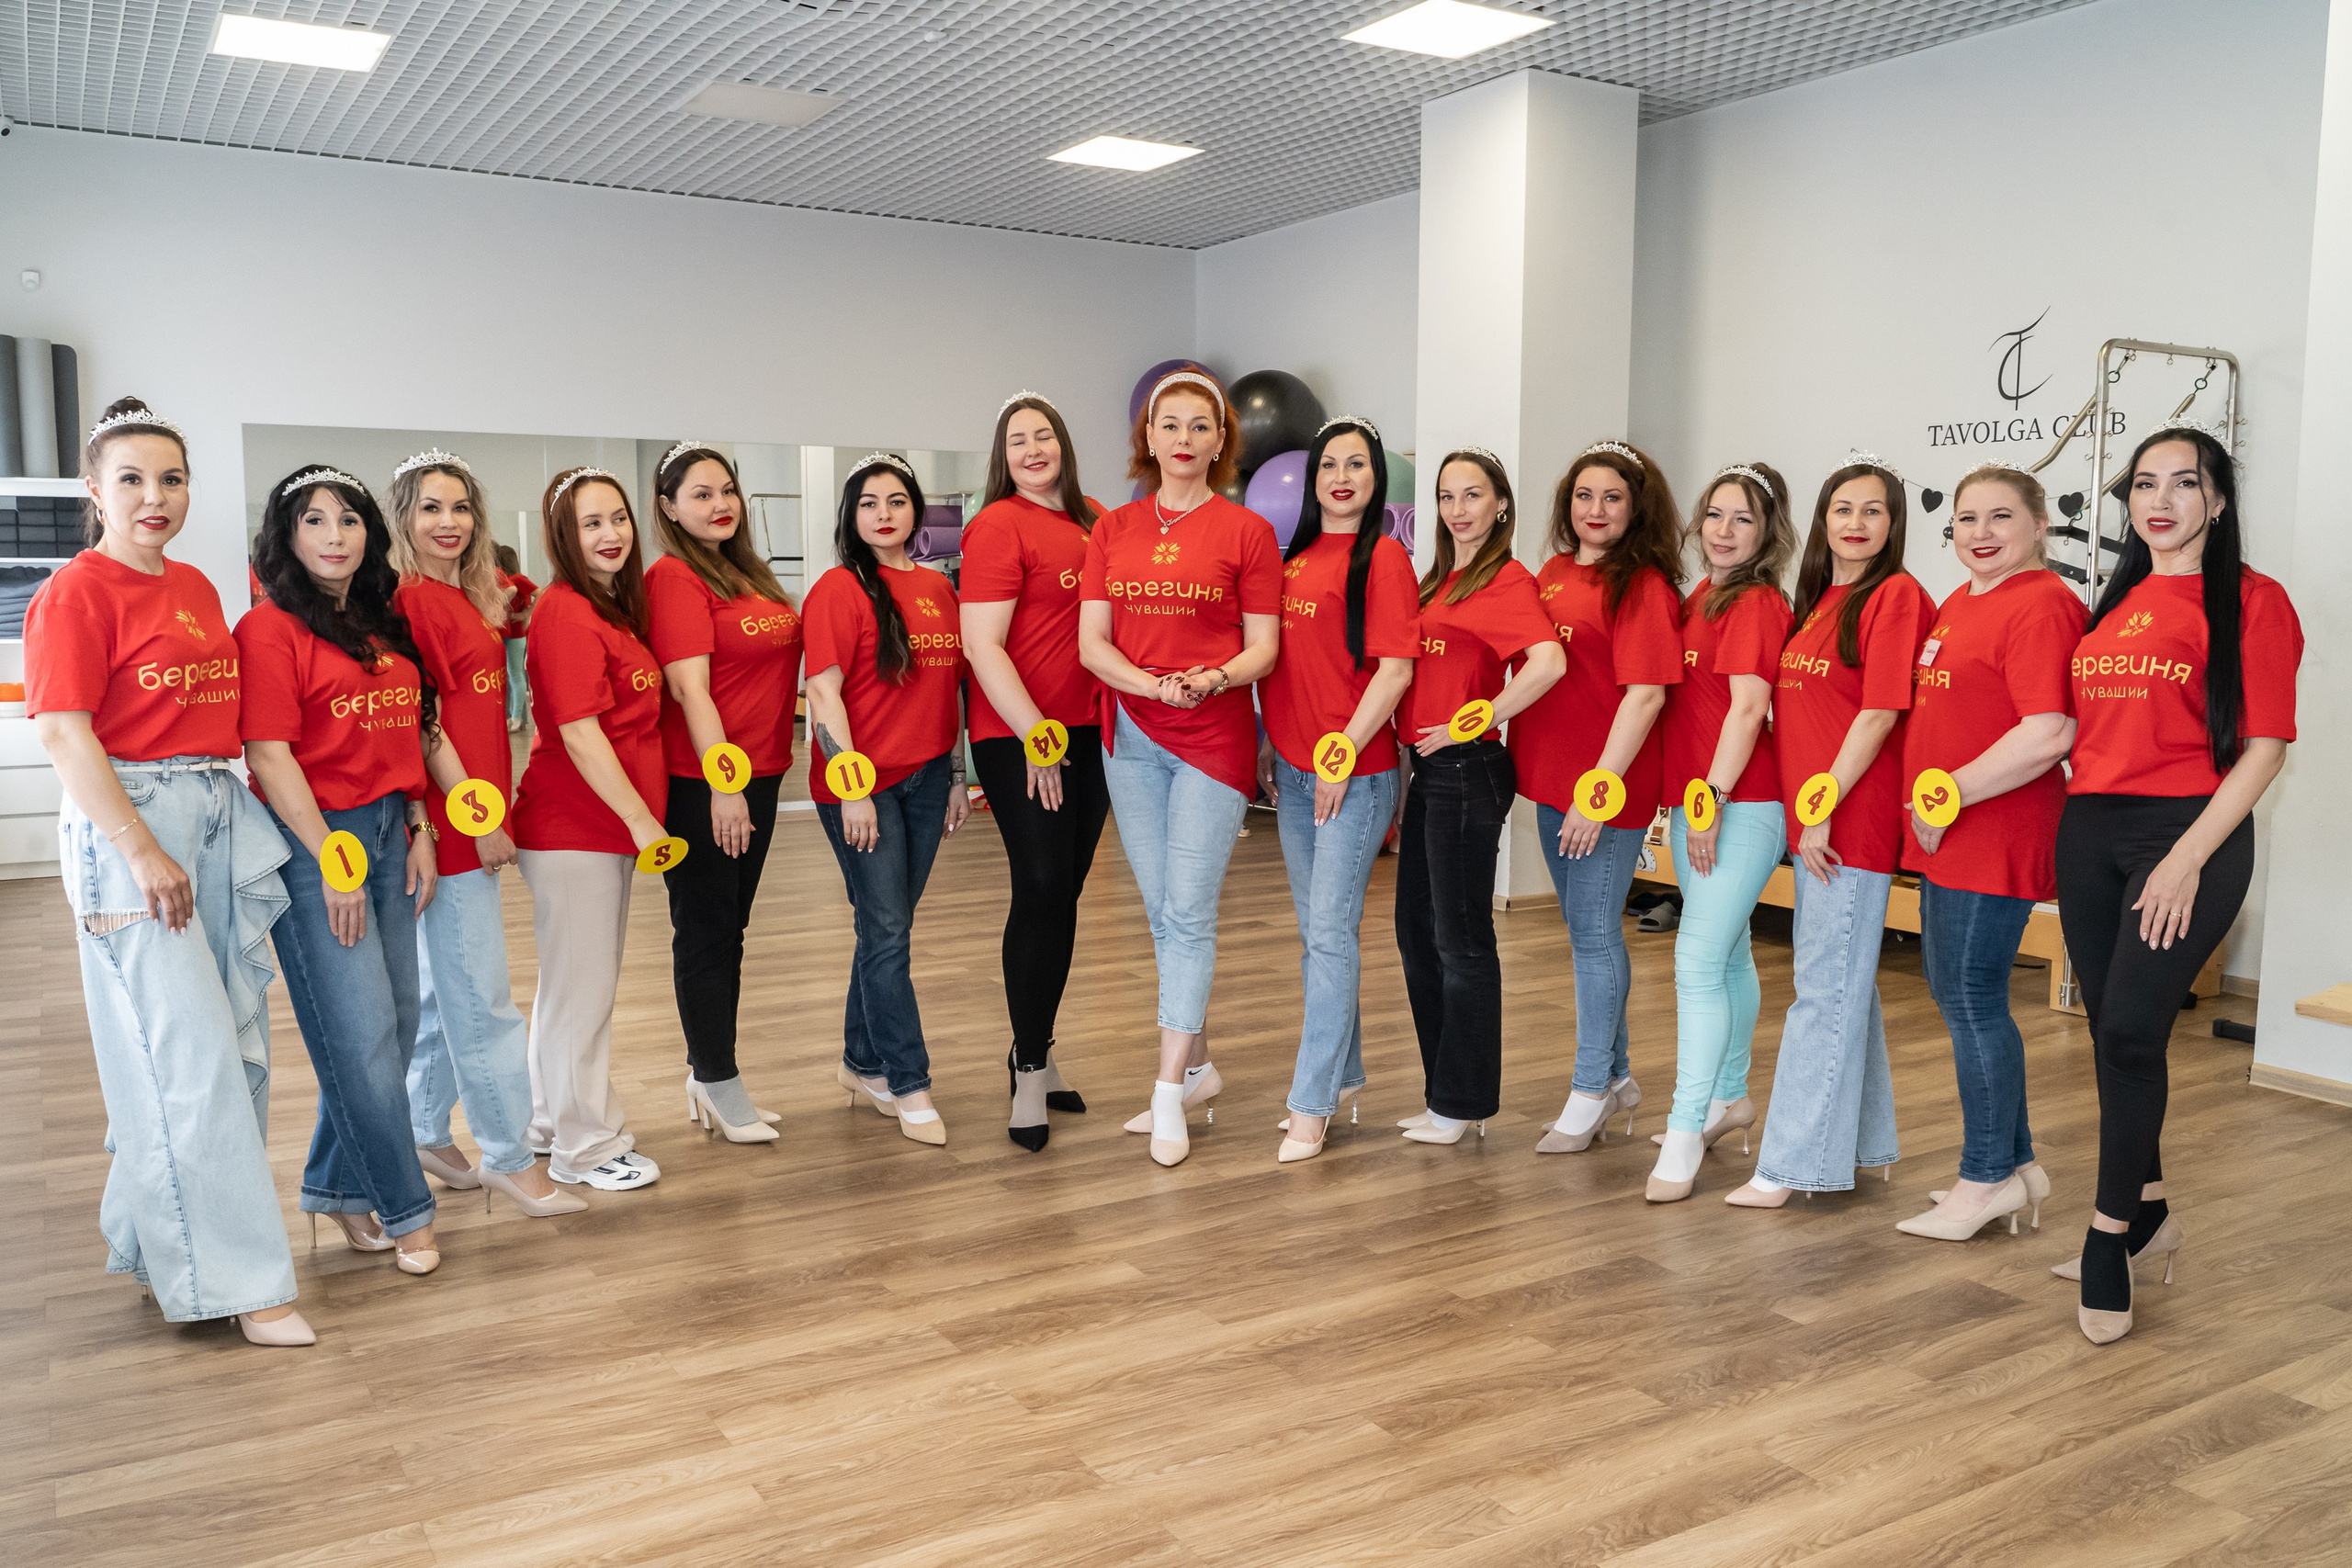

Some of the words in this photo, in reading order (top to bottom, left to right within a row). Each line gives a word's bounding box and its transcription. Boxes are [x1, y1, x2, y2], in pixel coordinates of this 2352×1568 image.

[1928, 417, 2044, 446] TAVOLGA
[1124, 604, 1195, 616] чувашии
[138, 658, 239, 691] береги
[2072, 655, 2193, 685] ерегиня
[1458, 706, 1485, 733] 10
[1031, 726, 1063, 760] 14
[1319, 740, 1347, 776] 12
[717, 752, 736, 784] 9
[838, 761, 865, 793] 11
[460, 789, 489, 824] 3
[1589, 780, 1610, 810] 8
[1693, 792, 1705, 818] 6
[1807, 785, 1827, 816] 4
[1920, 785, 1950, 813] 2
[334, 843, 355, 879] 1
[654, 843, 672, 867] 5
